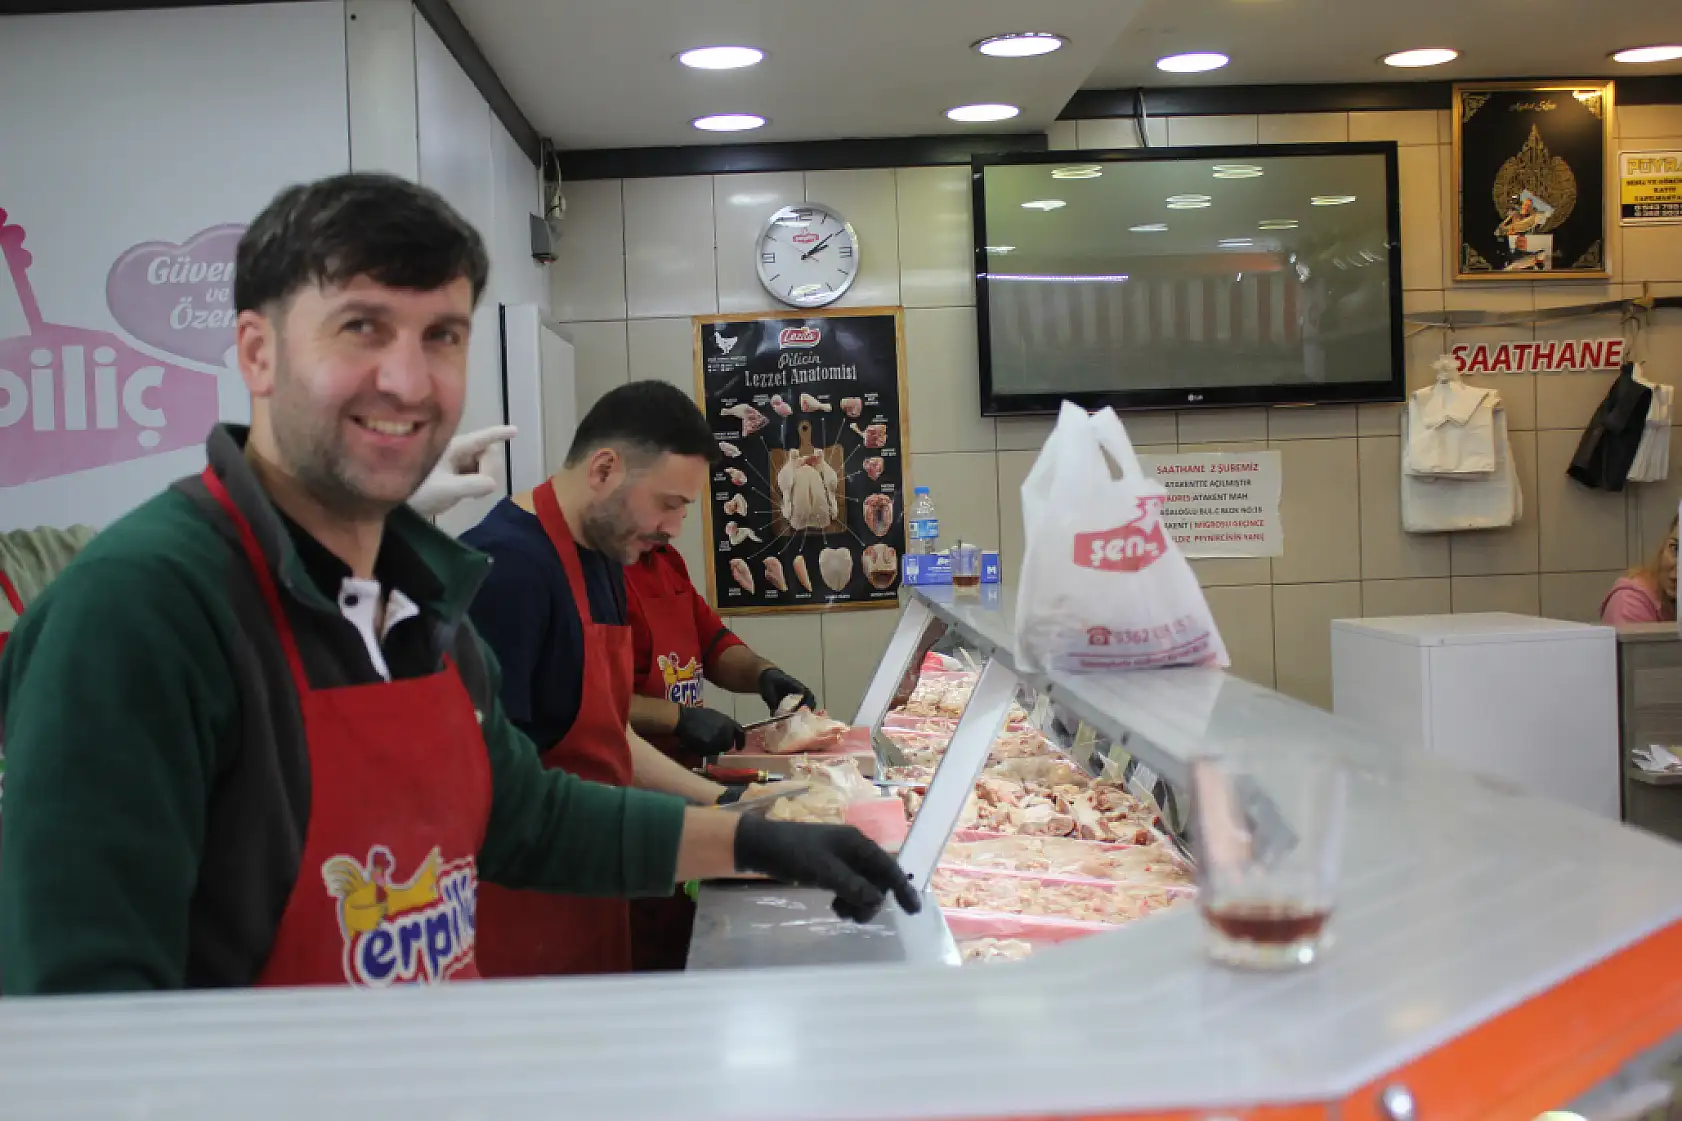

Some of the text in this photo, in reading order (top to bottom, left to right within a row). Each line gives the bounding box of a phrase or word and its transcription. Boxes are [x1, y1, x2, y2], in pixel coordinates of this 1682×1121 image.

[205, 287, 230, 302] ve
[1451, 338, 1625, 374] SAATHANE
[744, 370, 787, 388] Lezzet
[1156, 464, 1206, 474] SAATHANE
